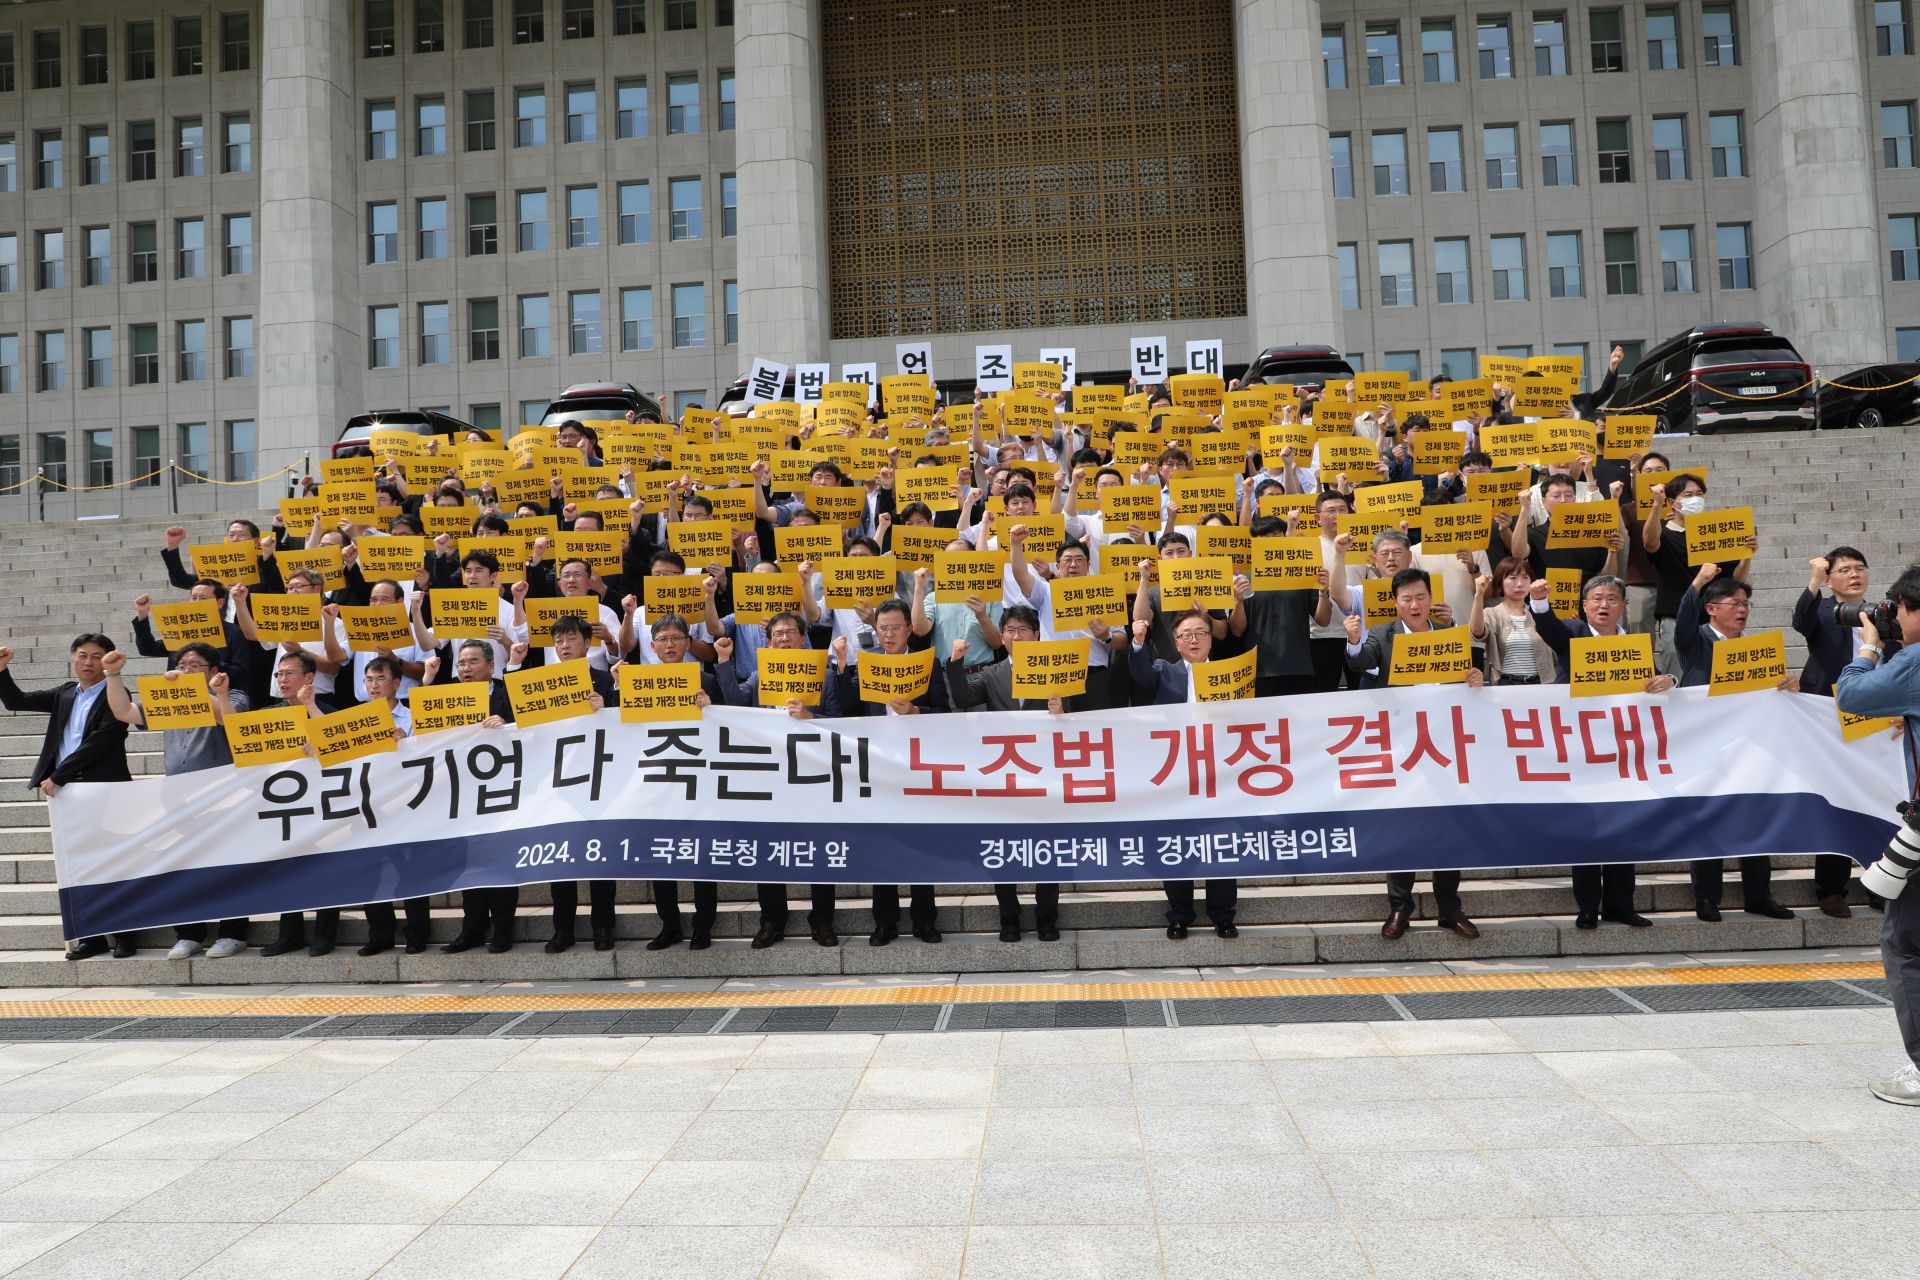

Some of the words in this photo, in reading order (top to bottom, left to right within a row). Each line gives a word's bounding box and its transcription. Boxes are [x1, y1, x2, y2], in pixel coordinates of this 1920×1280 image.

[980, 355, 1009, 379] 조
[1136, 345, 1164, 375] 반
[1191, 348, 1217, 373] 대
[753, 367, 780, 400] 불
[801, 371, 823, 400] 법
[1435, 517, 1453, 527] 경제
[1457, 514, 1482, 525] 망치는
[1425, 533, 1452, 542] 노조법
[1455, 531, 1471, 541] 개정
[1474, 529, 1488, 539] 반대
[835, 570, 854, 580] 경제
[857, 569, 885, 580] 망치는
[1173, 570, 1192, 581] 경제
[1195, 569, 1222, 579] 망치는
[827, 587, 852, 597] 노조법
[856, 586, 873, 596] 개정
[876, 585, 893, 596] 반대
[1064, 590, 1083, 601] 경제
[1086, 587, 1114, 599] 망치는
[1164, 586, 1191, 597] 노조법
[1194, 586, 1212, 596] 개정
[1214, 586, 1231, 595] 반대
[262, 606, 279, 615] 경제
[281, 606, 309, 616] 망치는
[442, 601, 459, 610] 경제
[461, 601, 487, 610] 망치는
[1056, 606, 1083, 618] 노조법
[1086, 604, 1104, 615] 개정
[1106, 602, 1124, 613] 반대
[257, 621, 278, 631] 노조법
[281, 622, 298, 631] 개정
[301, 621, 319, 630] 반대
[435, 617, 458, 626] 노조법
[461, 617, 477, 626] 개정
[479, 617, 496, 625] 반대
[1408, 645, 1430, 657] 경제
[1434, 642, 1463, 655] 망치는
[1586, 651, 1607, 663] 경제
[1611, 649, 1641, 662] 망치는
[1727, 652, 1744, 664] 경제
[1750, 647, 1776, 661] 망치는
[1027, 655, 1049, 667] 경제
[1052, 653, 1079, 666] 망치는
[768, 663, 784, 674] 경제
[788, 663, 817, 674] 망치는
[871, 666, 891, 677] 경제
[895, 665, 923, 678] 망치는
[1394, 663, 1426, 673] 노조법
[1430, 662, 1450, 671] 개정
[1714, 670, 1744, 683] 노조법
[1747, 667, 1766, 679] 개정
[1769, 664, 1785, 677] 반대
[1016, 674, 1046, 685] 노조법
[1050, 672, 1067, 684] 개정
[1070, 669, 1085, 680] 반대
[1208, 673, 1230, 686] 경제
[1574, 671, 1605, 682] 노조법
[1610, 669, 1629, 680] 개정
[1633, 668, 1652, 679] 반대
[522, 681, 544, 695] 경제
[546, 675, 578, 690] 망치는
[633, 679, 653, 690] 경제
[657, 677, 688, 689] 망치는
[761, 681, 783, 692] 노조법
[786, 682, 804, 693] 개정
[807, 681, 824, 694] 반대
[863, 680, 890, 693] 노조법
[894, 682, 912, 694] 개정
[915, 674, 929, 685] 반대
[150, 689, 168, 700] 경제
[170, 688, 196, 699] 망치는
[624, 697, 653, 708] 노조법
[656, 696, 676, 707] 개정
[678, 694, 698, 706] 반대
[147, 707, 171, 716] 노조법
[172, 705, 190, 715] 개정
[191, 703, 210, 714] 반대
[423, 699, 443, 711] 경제
[446, 696, 475, 708] 망치는
[516, 700, 546, 714] 노조법
[549, 694, 569, 706] 개정
[323, 724, 346, 737] 경제
[347, 716, 380, 731] 망치는
[416, 717, 443, 729] 노조법
[446, 715, 464, 726] 개정
[467, 713, 485, 724] 반대
[240, 724, 261, 736] 경제
[263, 721, 294, 733] 망치는
[234, 742, 263, 754] 노조법
[265, 739, 284, 750] 개정
[286, 736, 306, 748] 반대
[319, 741, 350, 755] 노조법
[351, 734, 372, 746] 개정
[373, 729, 394, 738] 반대
[258, 763, 376, 840] 우리
[402, 740, 522, 818] 기업
[553, 730, 613, 800] 다
[639, 727, 871, 802] 죽는다!
[904, 729, 1115, 803] 노조법
[1152, 719, 1293, 797] 개정
[1328, 706, 1475, 788] 결사
[1504, 706, 1672, 781] 반대!
[516, 841, 575, 868] 2024.
[586, 839, 606, 861] 8.
[621, 839, 639, 861] 1.
[651, 838, 699, 864] 국회
[709, 839, 757, 866] 본청
[768, 841, 816, 866] 계단
[826, 842, 849, 867] 앞
[980, 838, 1107, 868] 경제6단체
[1120, 837, 1144, 865] 및
[1157, 827, 1356, 865] 경제단체협의회
